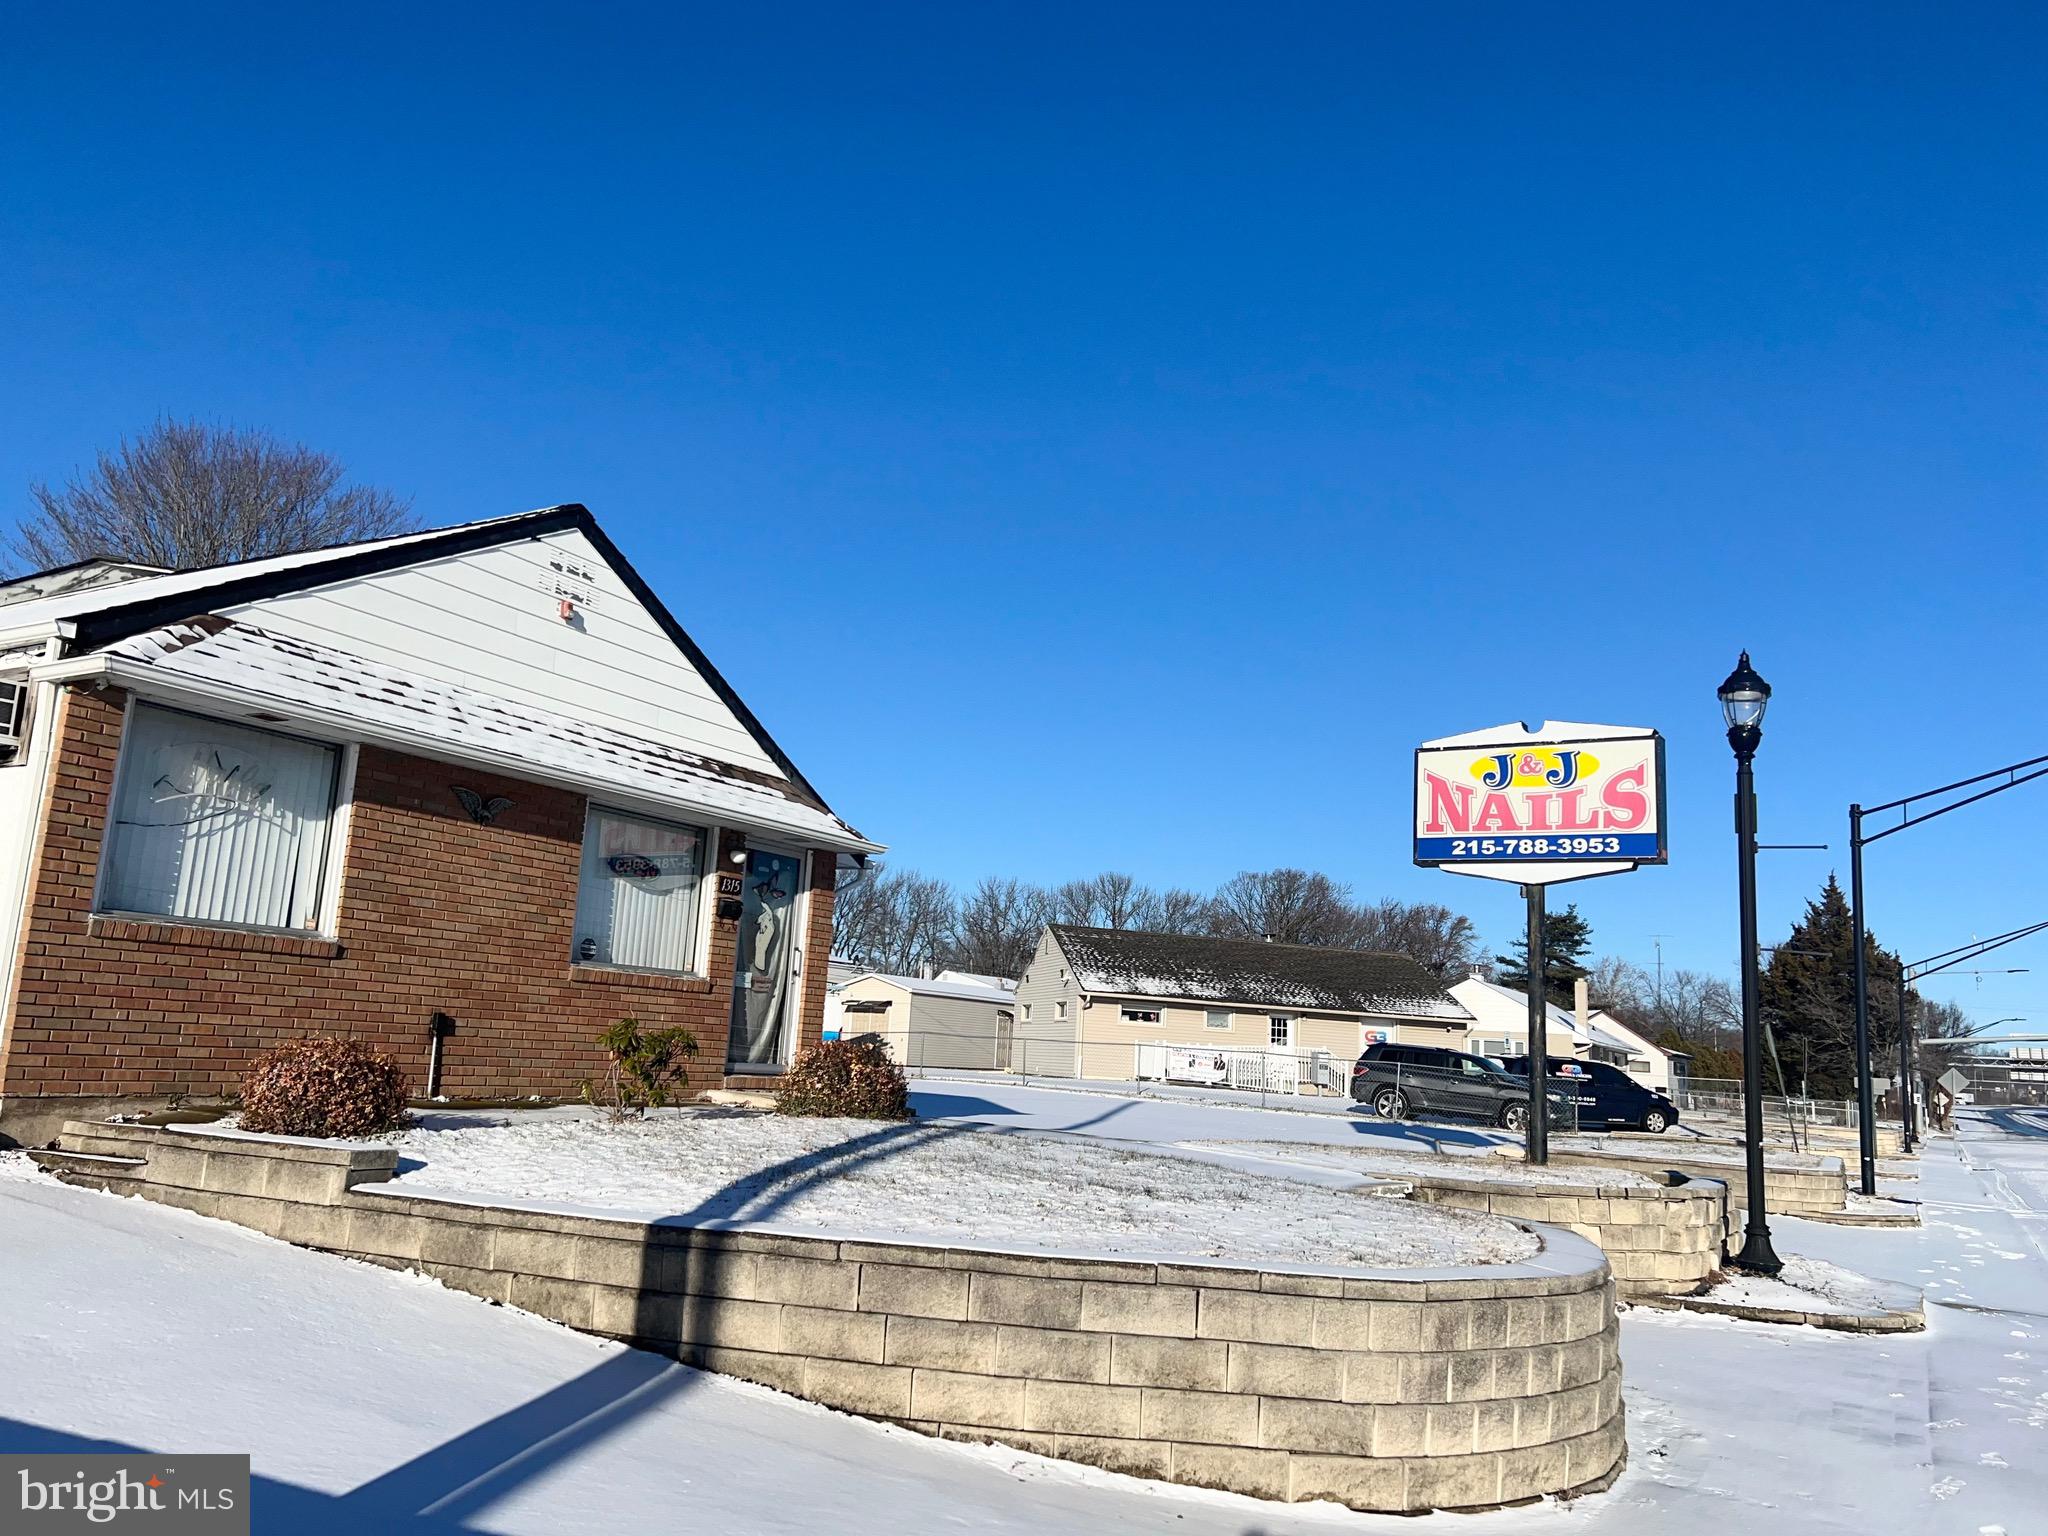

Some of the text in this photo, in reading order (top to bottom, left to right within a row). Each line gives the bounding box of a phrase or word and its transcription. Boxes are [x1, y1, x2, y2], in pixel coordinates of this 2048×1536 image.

[1424, 759, 1650, 834] NAILS
[1451, 837, 1620, 855] 215-788-3953
[721, 878, 741, 892] 1315
